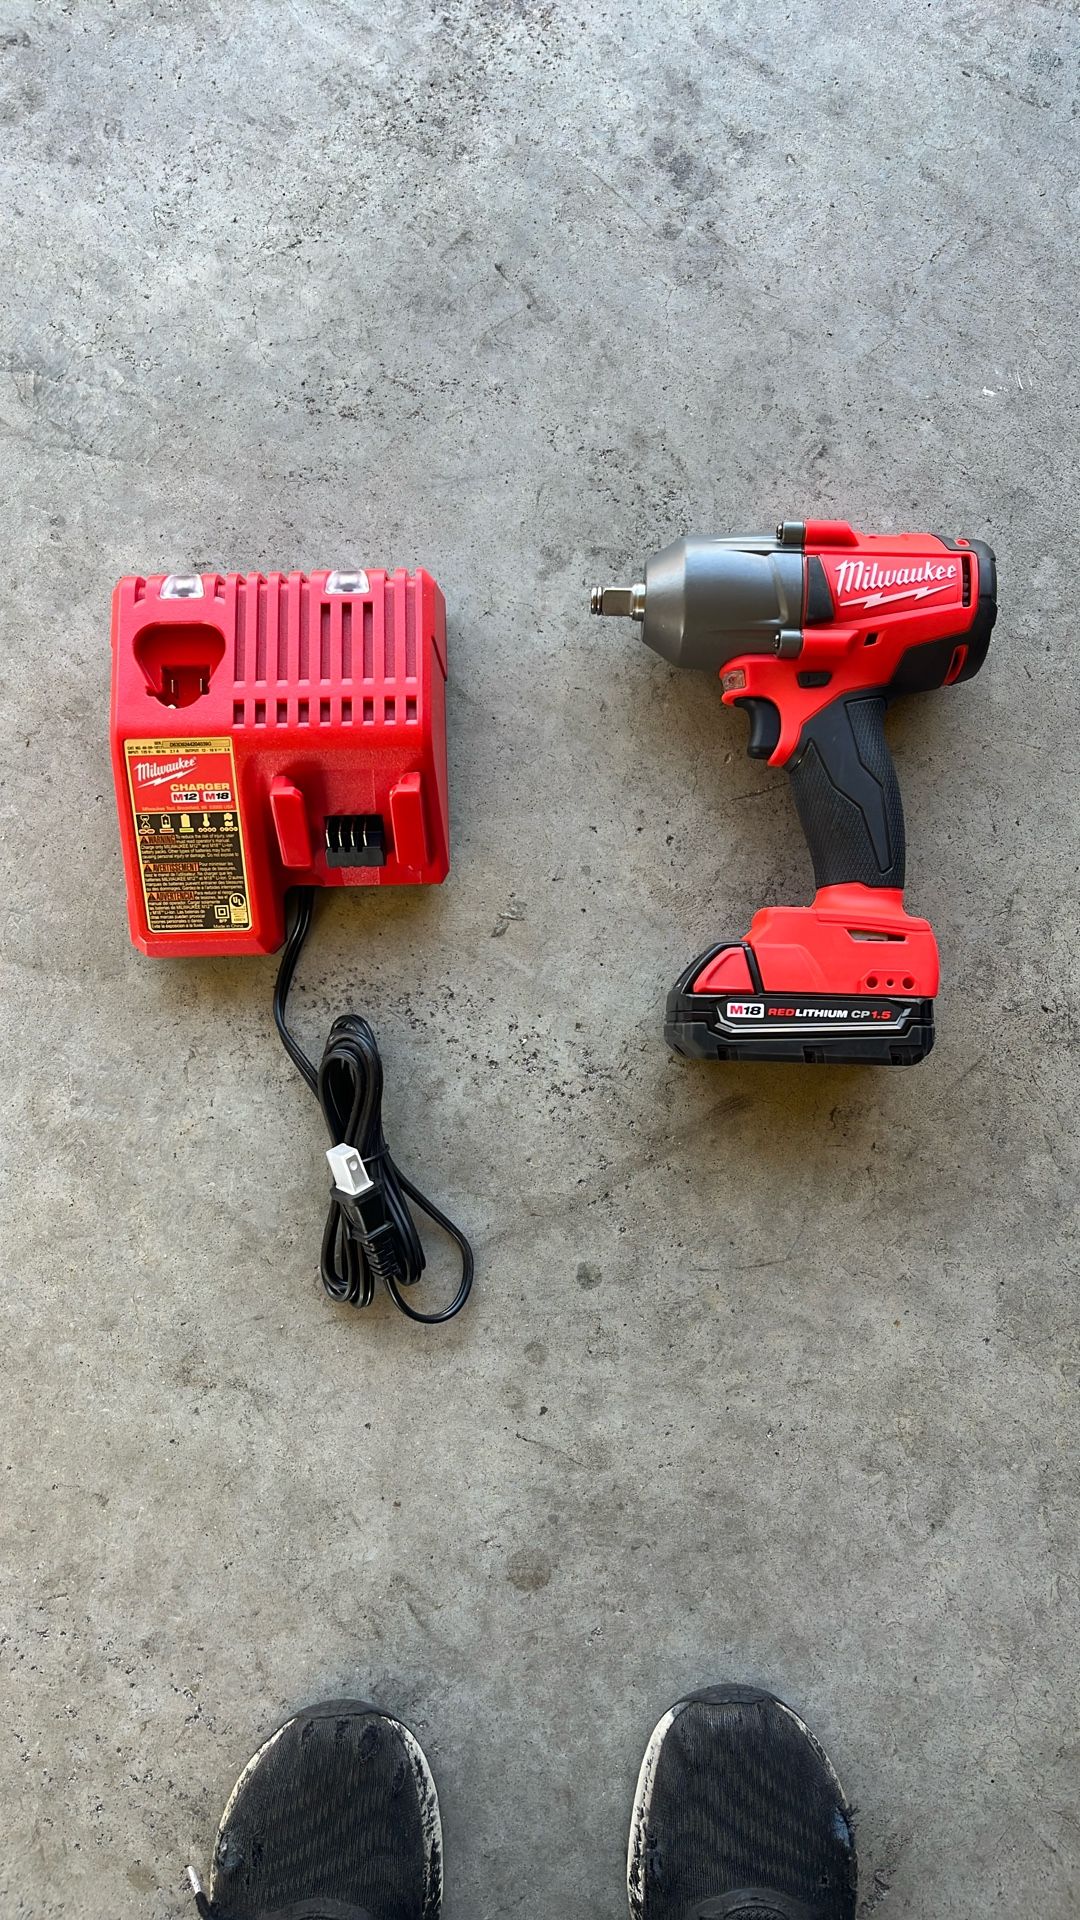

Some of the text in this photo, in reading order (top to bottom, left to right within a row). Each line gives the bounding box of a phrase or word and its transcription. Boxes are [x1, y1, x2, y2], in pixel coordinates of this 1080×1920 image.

[835, 560, 957, 597] Milwaukee
[134, 757, 196, 782] Milwaukee
[170, 783, 230, 791] CHARGER
[730, 1005, 762, 1016] M18
[768, 1008, 848, 1018] REDLITHIUM
